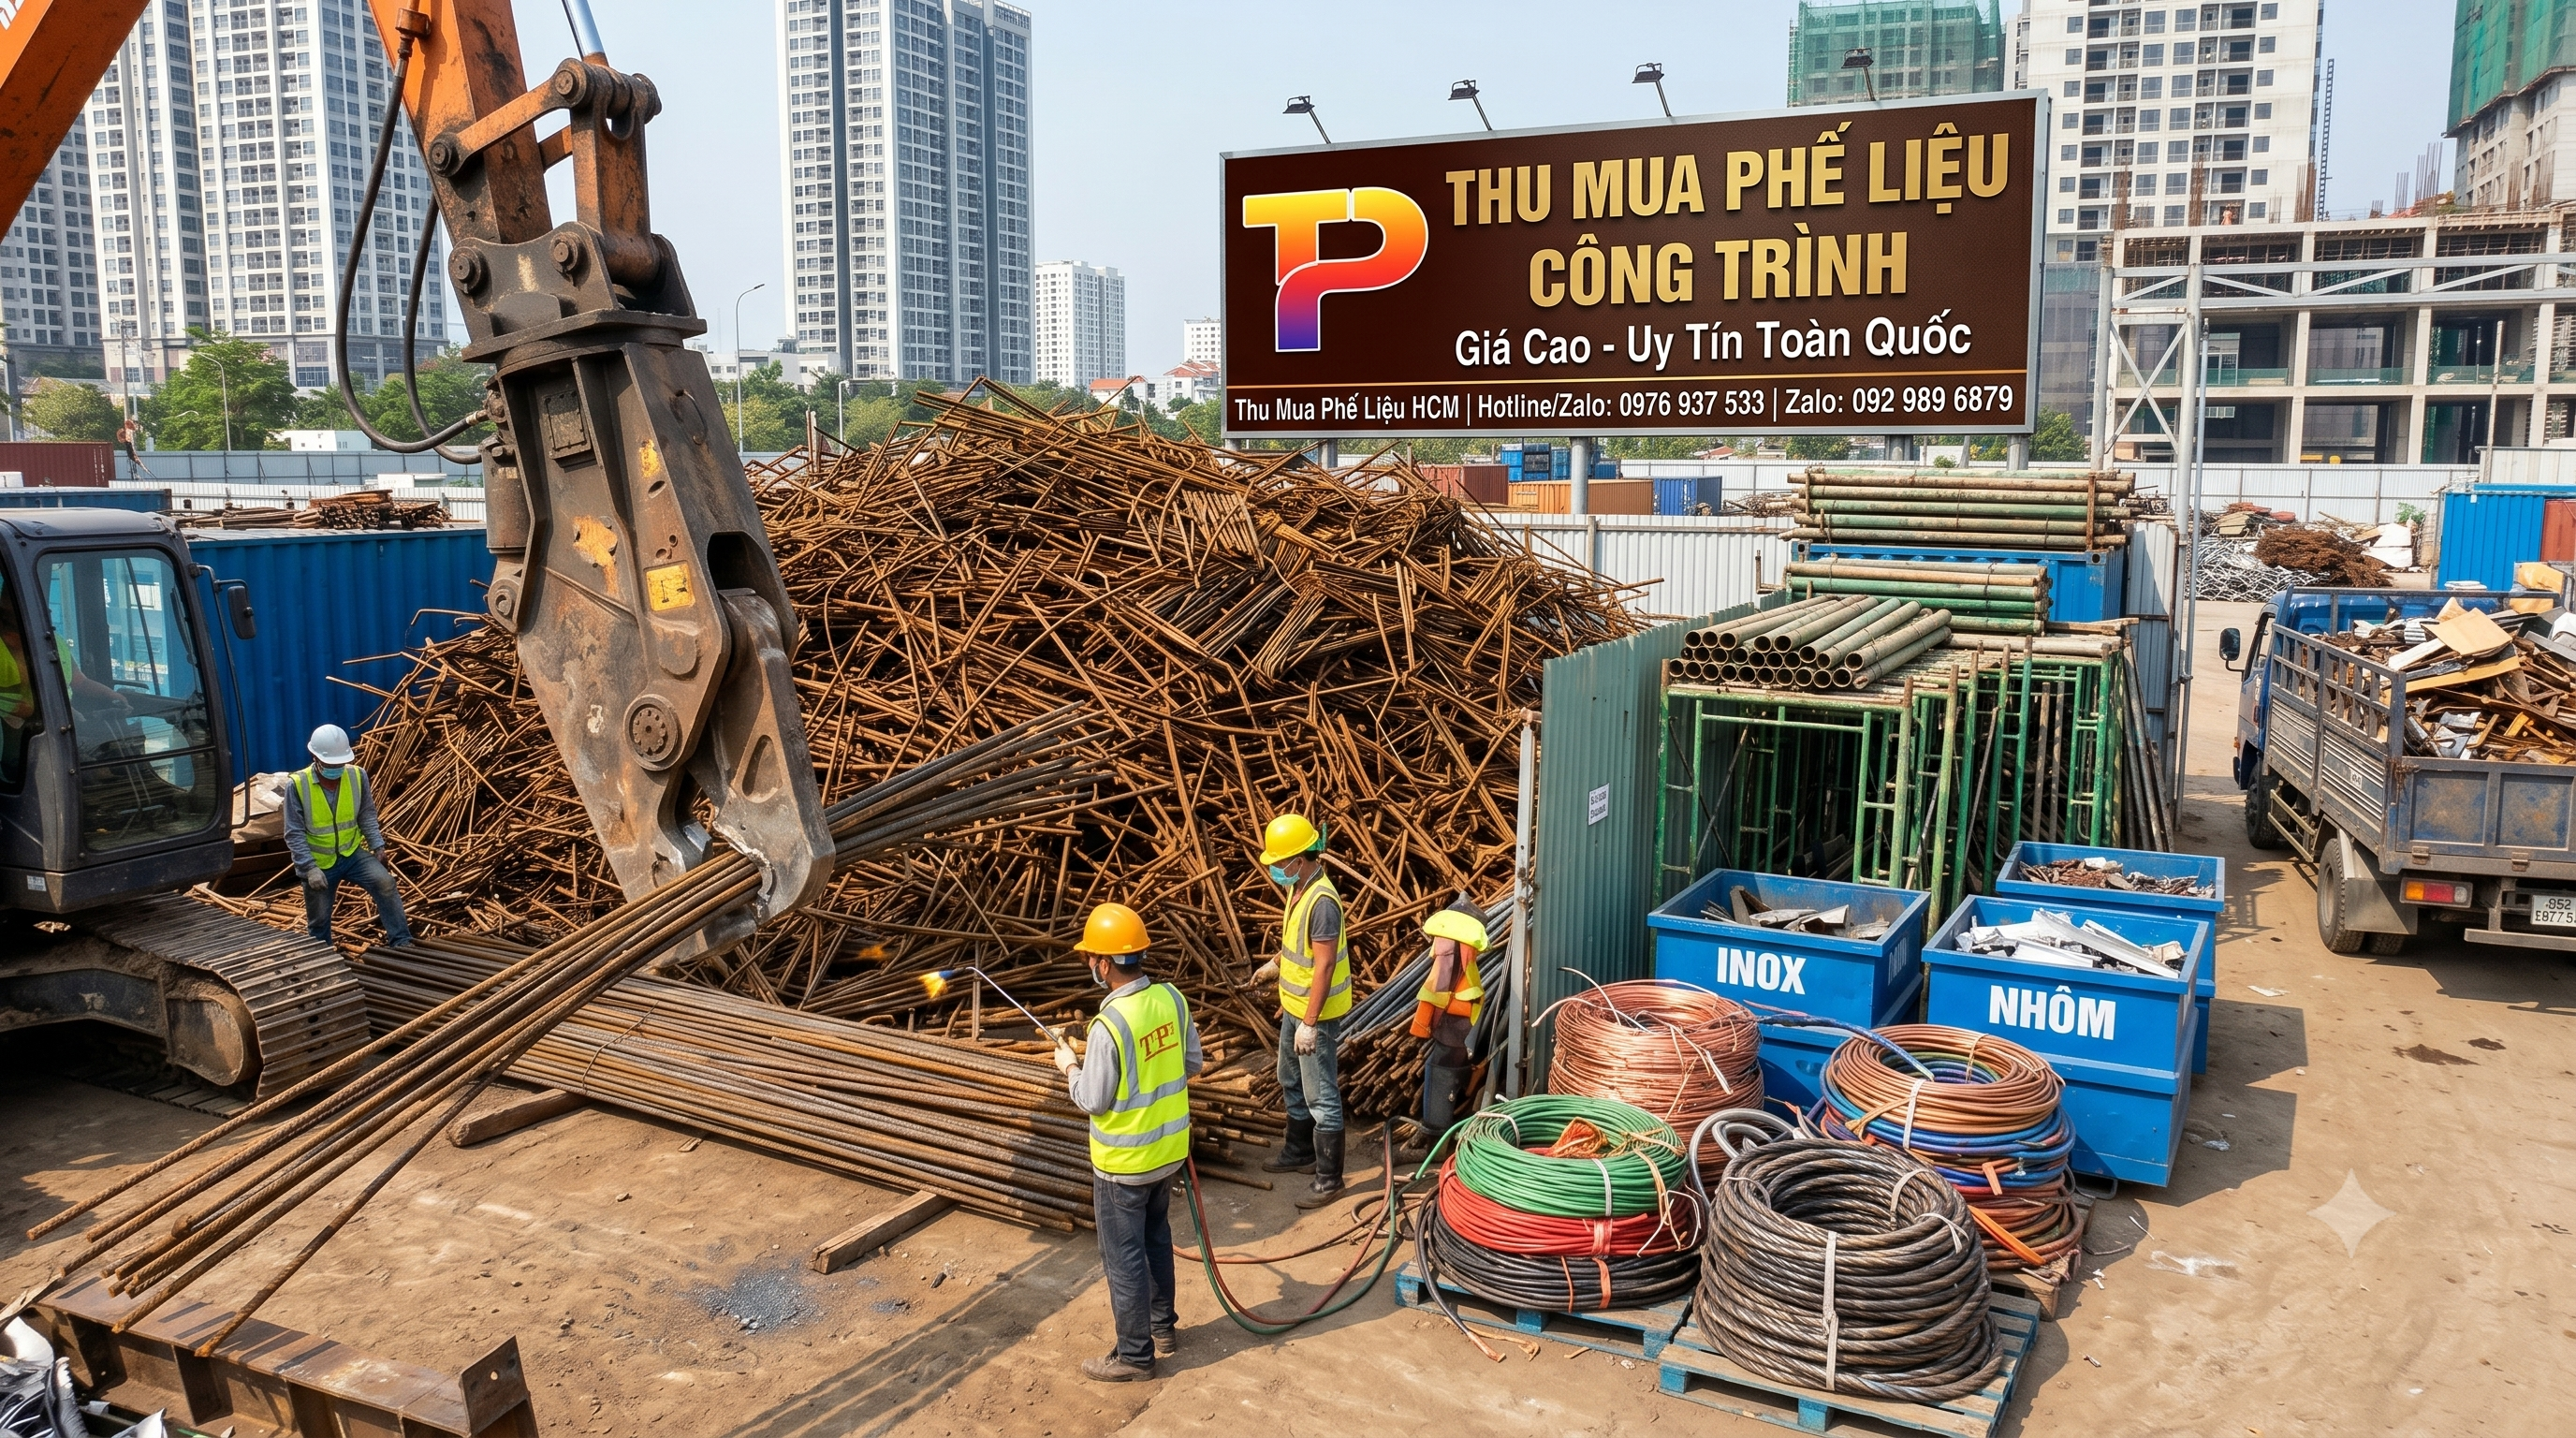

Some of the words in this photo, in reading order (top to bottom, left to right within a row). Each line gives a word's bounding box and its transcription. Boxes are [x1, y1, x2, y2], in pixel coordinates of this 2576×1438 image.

[1445, 164, 1551, 227] THU
[1573, 154, 1705, 220] MUA
[1726, 121, 1852, 211] PHẾ
[1868, 122, 2010, 214] LIỆU
[1242, 186, 1429, 353] TP
[1530, 233, 1693, 308] CÔNG
[1714, 222, 1908, 301] TRÌNH
[1455, 328, 1511, 366] Giá
[1523, 328, 1591, 365] Cao
[1628, 324, 1675, 372] Uy
[1685, 320, 1743, 360] Tín
[1755, 318, 1851, 359] Toàn
[1865, 308, 1971, 358] Quốc
[1234, 397, 1268, 421] Thu
[1276, 397, 1315, 420] Mua
[1321, 392, 1359, 420] Phế
[1364, 395, 1405, 425] Liệu
[1412, 394, 1459, 419] HCM
[1478, 392, 1613, 418] Hotline/Zalo:
[1619, 391, 1671, 417] 0976
[1677, 390, 1719, 416] 937
[1724, 389, 1764, 416] 533
[1784, 388, 1843, 414] Zalo:
[1852, 387, 1895, 414] 092
[1902, 386, 1946, 413] 989
[1954, 385, 2013, 412] 6879
[1717, 946, 1807, 995] INOX
[1988, 985, 2116, 1041] NHÔM
